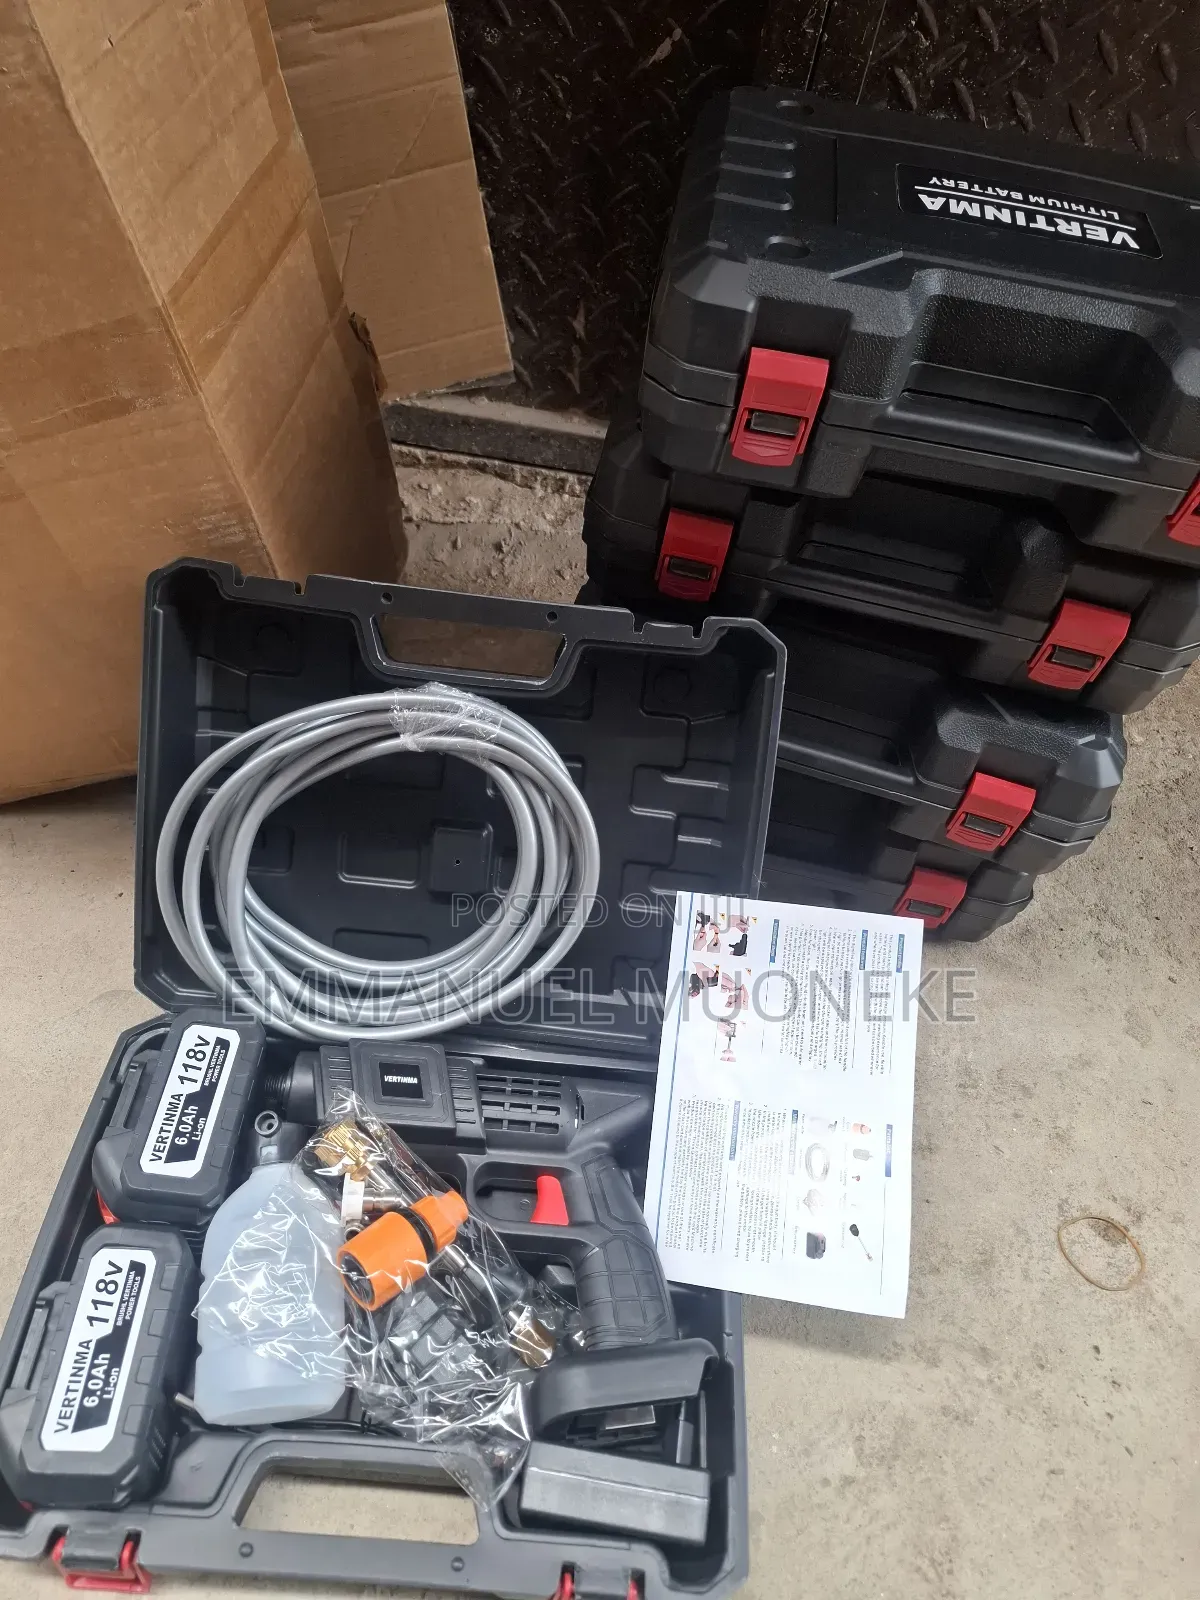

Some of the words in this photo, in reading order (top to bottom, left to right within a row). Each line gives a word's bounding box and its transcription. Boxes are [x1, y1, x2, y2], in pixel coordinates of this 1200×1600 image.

[928, 176, 1023, 200] BATTERY
[918, 194, 1140, 249] VERTINMA
[1028, 194, 1119, 221] LITHIUM
[212, 1065, 221, 1082] POWER
[217, 1049, 226, 1064] TOOLS
[384, 1075, 418, 1084] VERTINMA
[149, 1093, 184, 1162] VERTINMA
[175, 1105, 198, 1145] 6.0Ah
[122, 1271, 135, 1299] VERTINMA
[125, 1297, 135, 1320] POWER
[133, 1276, 141, 1296] TOOLS
[54, 1339, 93, 1434] VERTINMA
[83, 1353, 111, 1408] 6.0Ah
[102, 1367, 120, 1399] Li-on
